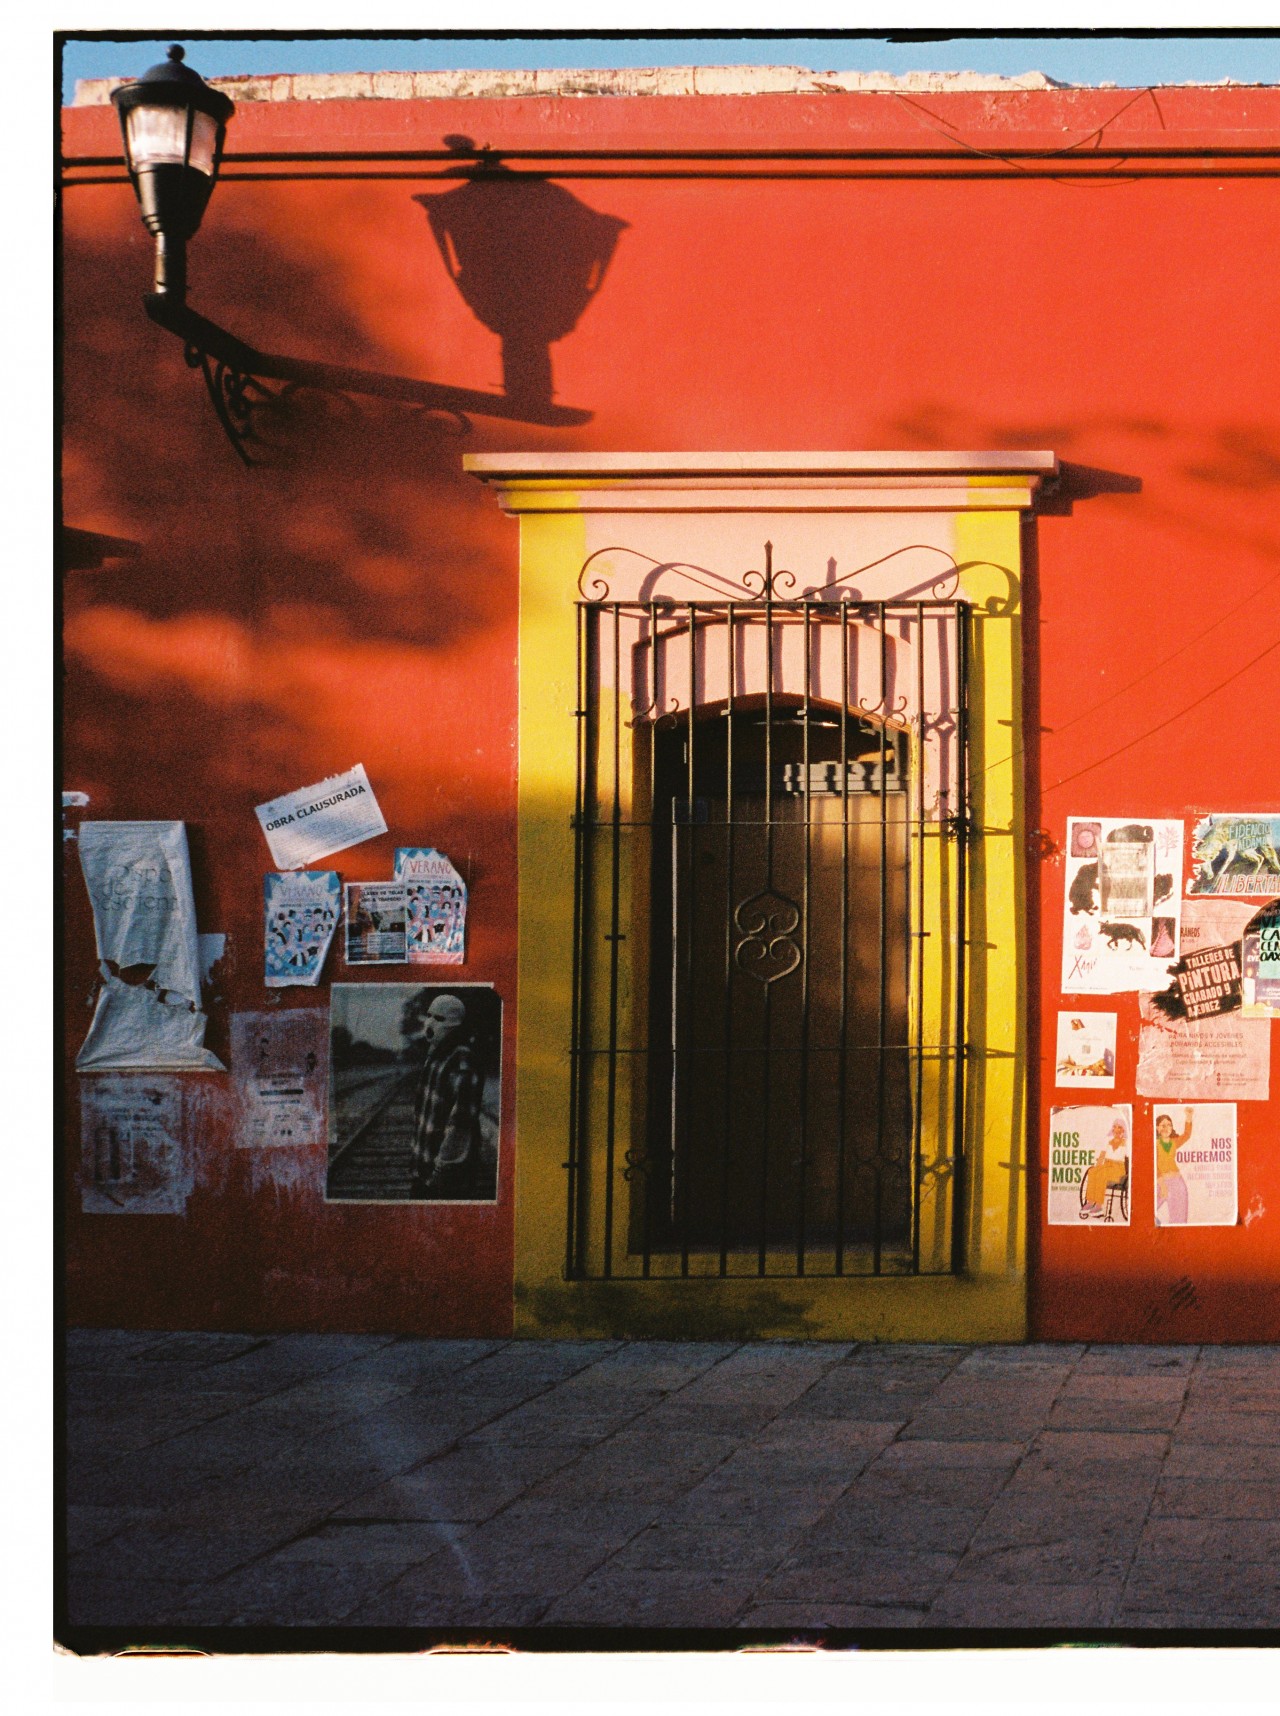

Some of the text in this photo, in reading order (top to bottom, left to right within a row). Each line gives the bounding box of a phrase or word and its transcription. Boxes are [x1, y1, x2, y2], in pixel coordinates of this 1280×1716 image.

[265, 785, 366, 831] OBRA CLAUSURADA
[1229, 823, 1271, 839] FIDENCIO
[409, 861, 452, 875] VERANO
[1185, 948, 1235, 969] TALLERES DE
[1183, 985, 1223, 1005] GRABADO
[1187, 1000, 1220, 1018] AJEDREZ
[1053, 1131, 1080, 1148] NOS
[1211, 1138, 1232, 1149] NOS
[1052, 1149, 1095, 1166] QUERE
[1176, 1151, 1232, 1163] QUEREMOS
[1052, 1167, 1082, 1184] MOS
